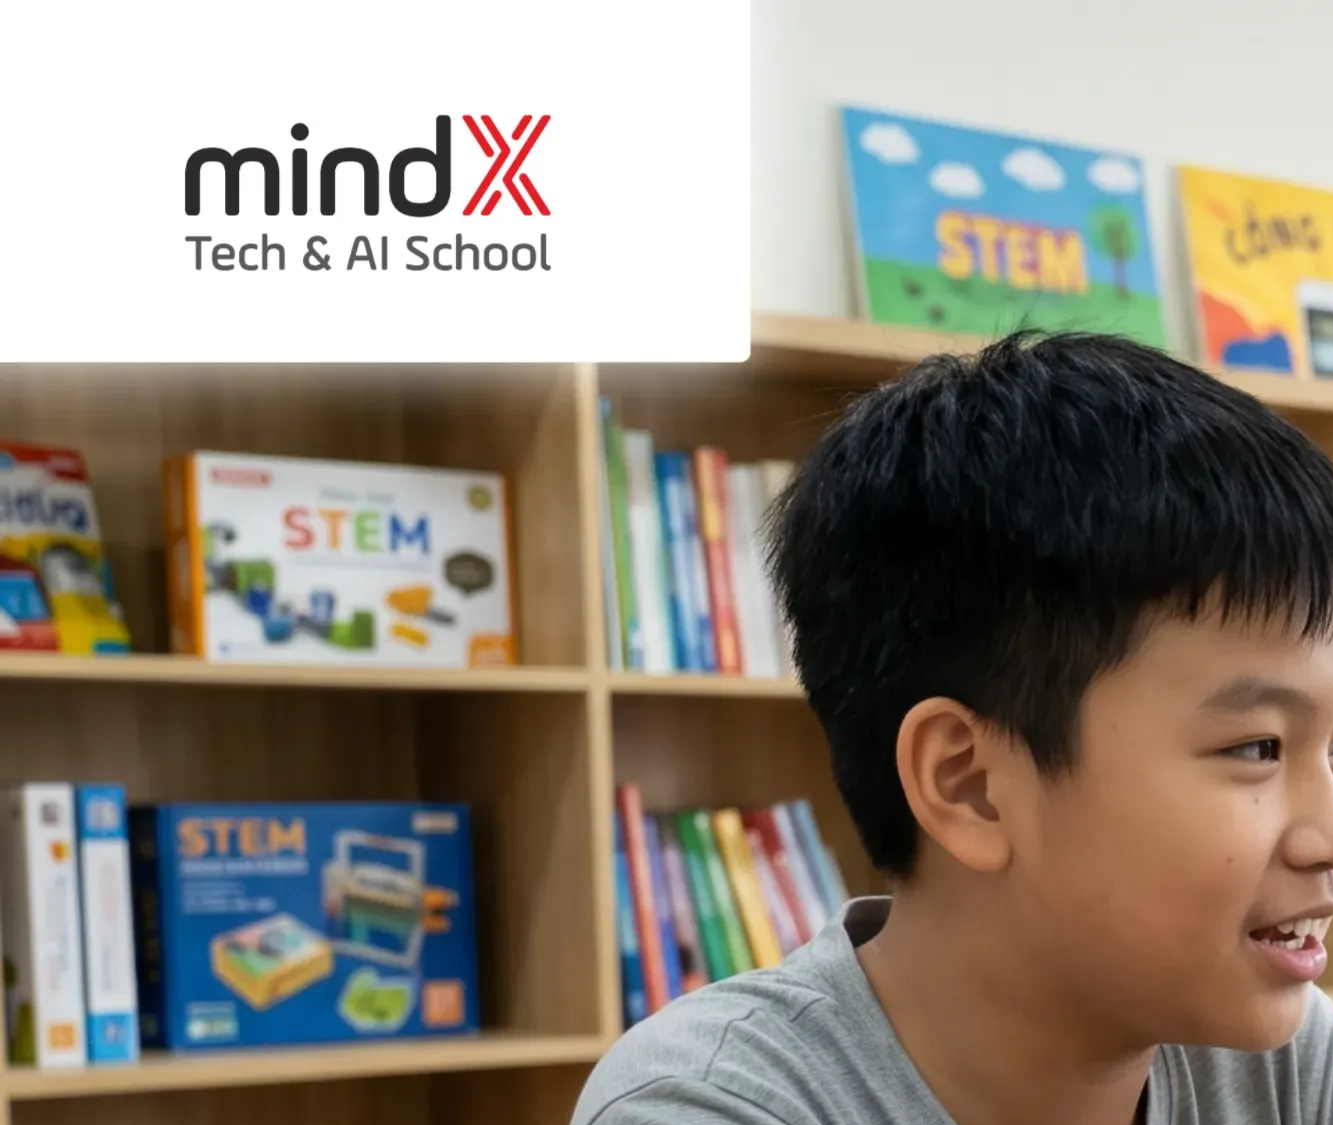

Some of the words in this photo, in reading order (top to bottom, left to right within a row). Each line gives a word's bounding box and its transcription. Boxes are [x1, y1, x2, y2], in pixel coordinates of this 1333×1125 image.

[935, 209, 1089, 295] STEM
[282, 505, 431, 555] STEM
[177, 816, 307, 858] STEM
